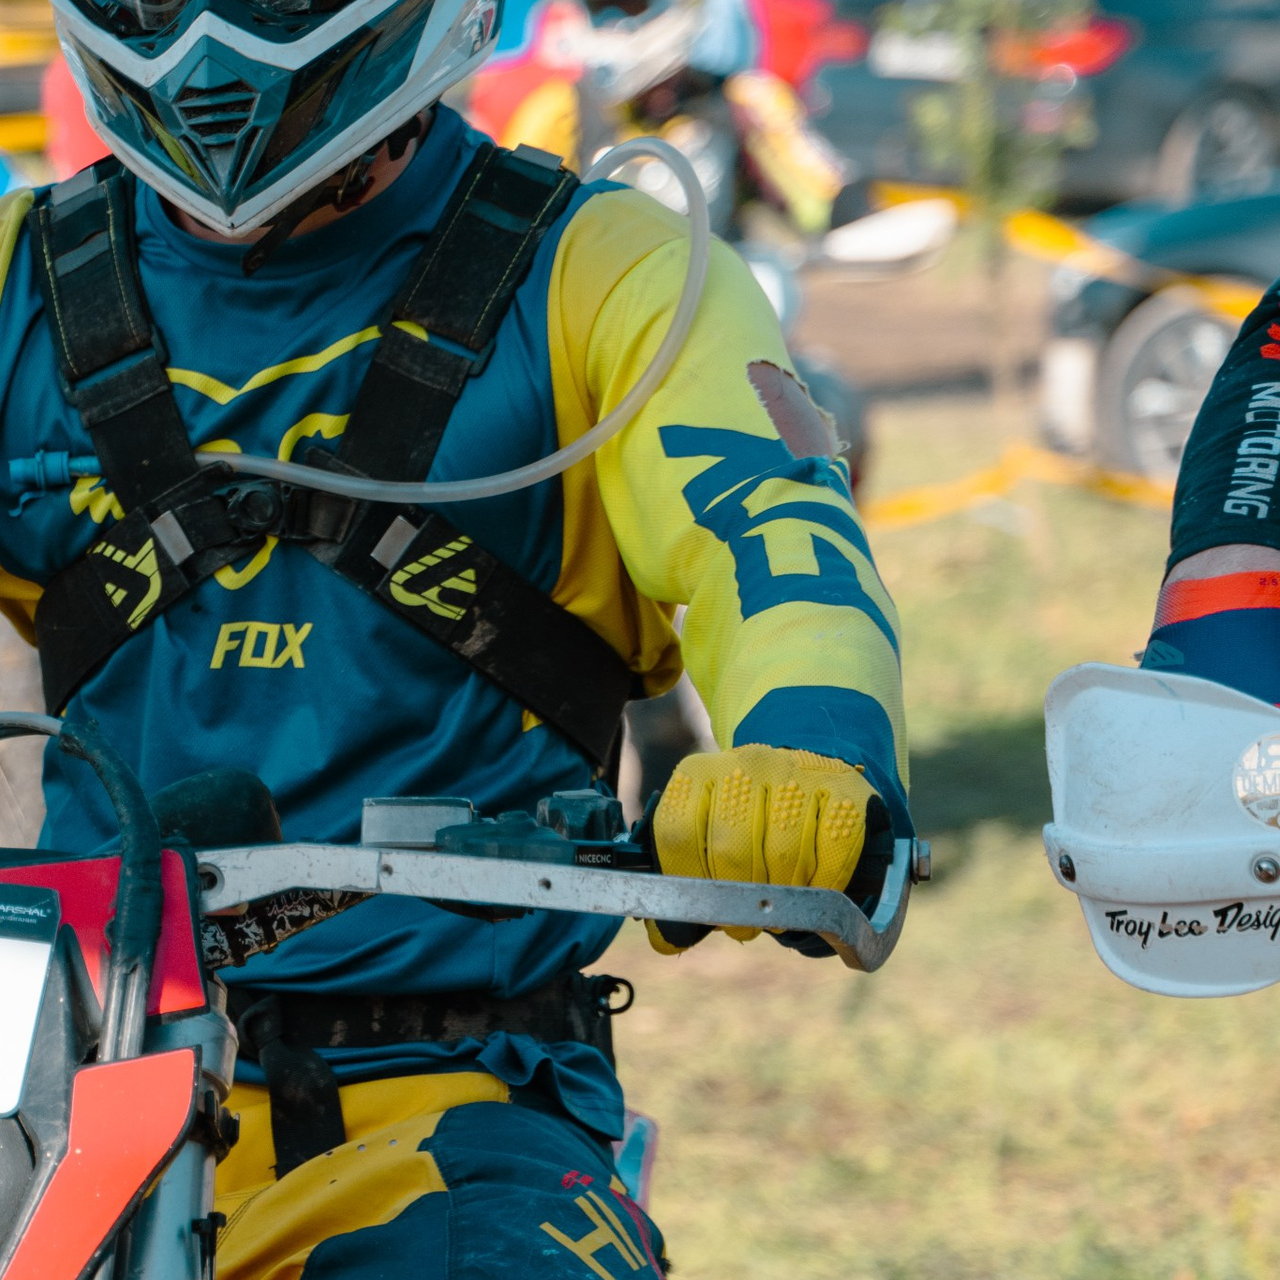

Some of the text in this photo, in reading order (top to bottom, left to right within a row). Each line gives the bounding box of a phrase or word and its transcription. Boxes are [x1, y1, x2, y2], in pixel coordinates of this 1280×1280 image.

[209, 620, 314, 669] FOX
[578, 853, 612, 864] NICECNC
[1105, 909, 1154, 950] Troy
[1157, 910, 1208, 939] Lee
